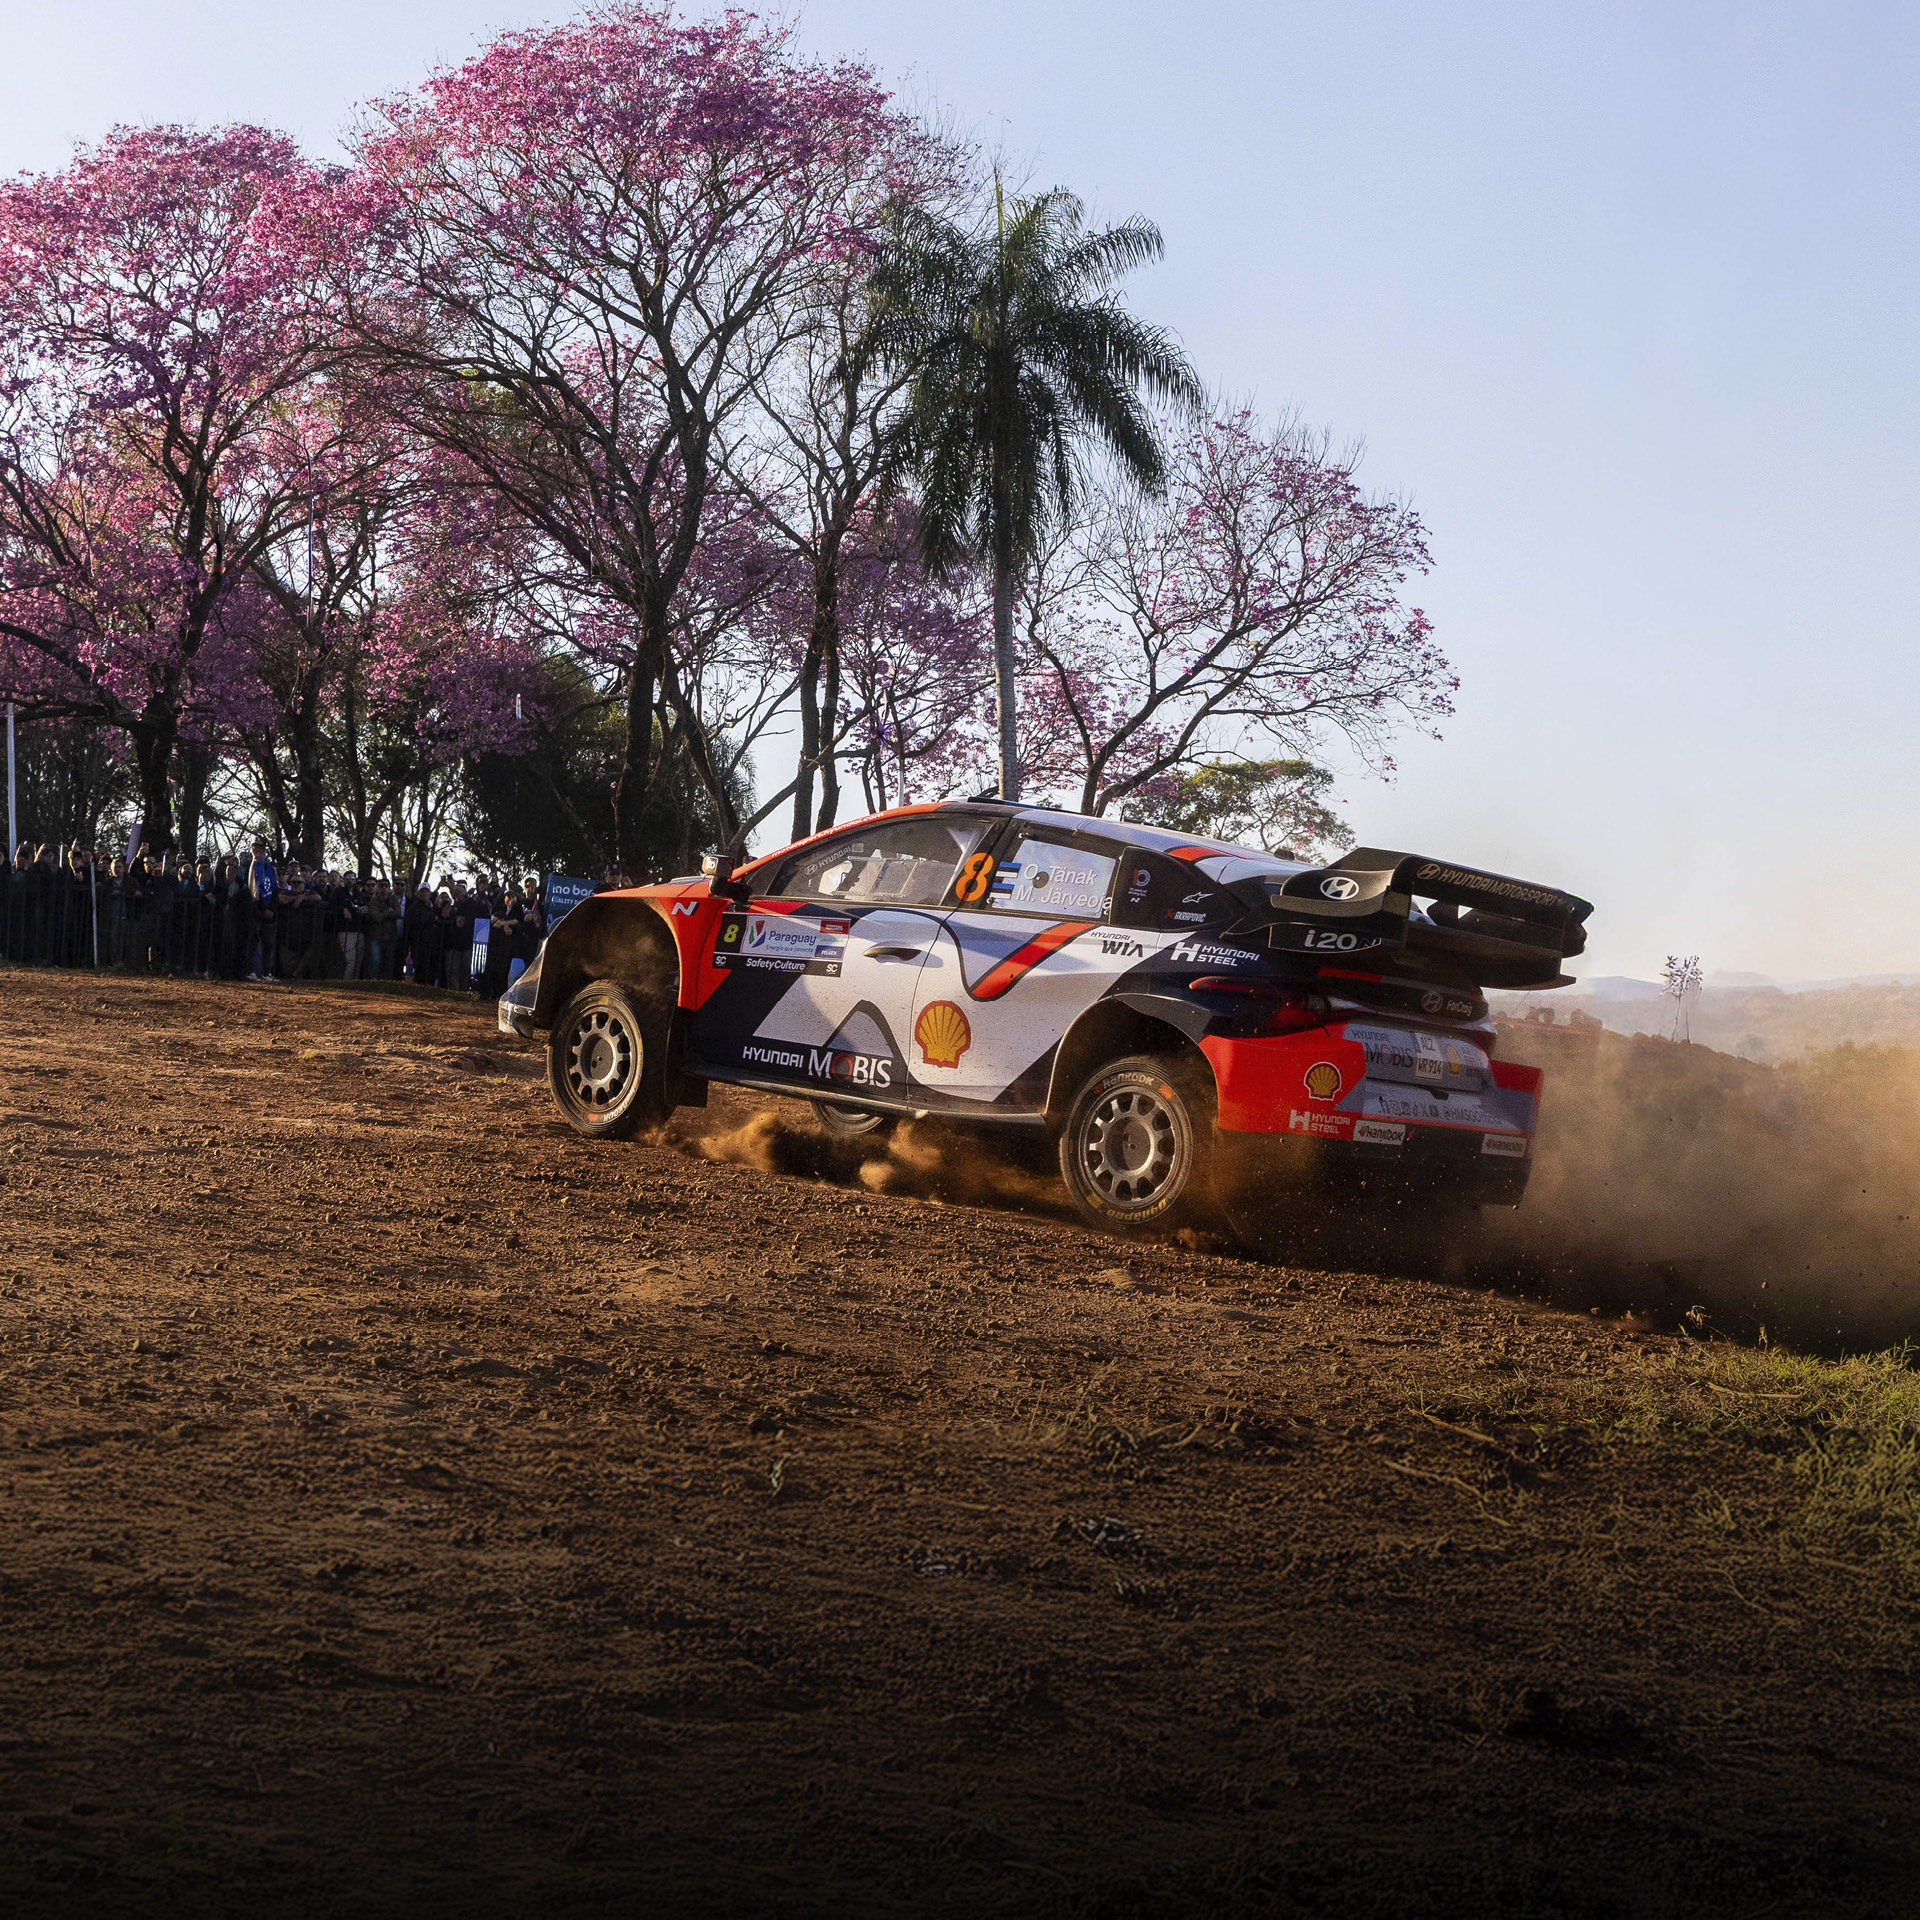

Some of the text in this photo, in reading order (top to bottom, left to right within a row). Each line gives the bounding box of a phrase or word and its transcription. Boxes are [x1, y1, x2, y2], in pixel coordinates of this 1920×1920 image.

[771, 811, 884, 858] motorsport.hyundai.com
[818, 845, 852, 868] HYUNDAI
[955, 852, 994, 902] 8
[1049, 866, 1097, 886] Tänak
[1016, 885, 1113, 913] M. Järveoja
[723, 924, 739, 943] 8
[768, 930, 817, 946] Paraguay
[1090, 931, 1132, 941] HYUNDAI
[1303, 929, 1357, 951] i20
[1102, 939, 1144, 958] WIA
[1202, 944, 1261, 961] HYUNDAI
[715, 955, 727, 965] SC
[746, 957, 806, 971] SafetyCulture
[826, 963, 838, 973] SC
[1197, 954, 1238, 967] STEEL
[1352, 1030, 1390, 1042] HYUNDAI
[742, 1046, 804, 1068] HYUNDAI
[1364, 1042, 1414, 1069] MOBIS
[808, 1049, 892, 1088] MOBIS
[1310, 1123, 1340, 1135] STEEL
[1312, 1113, 1351, 1126] HYUNDAI
